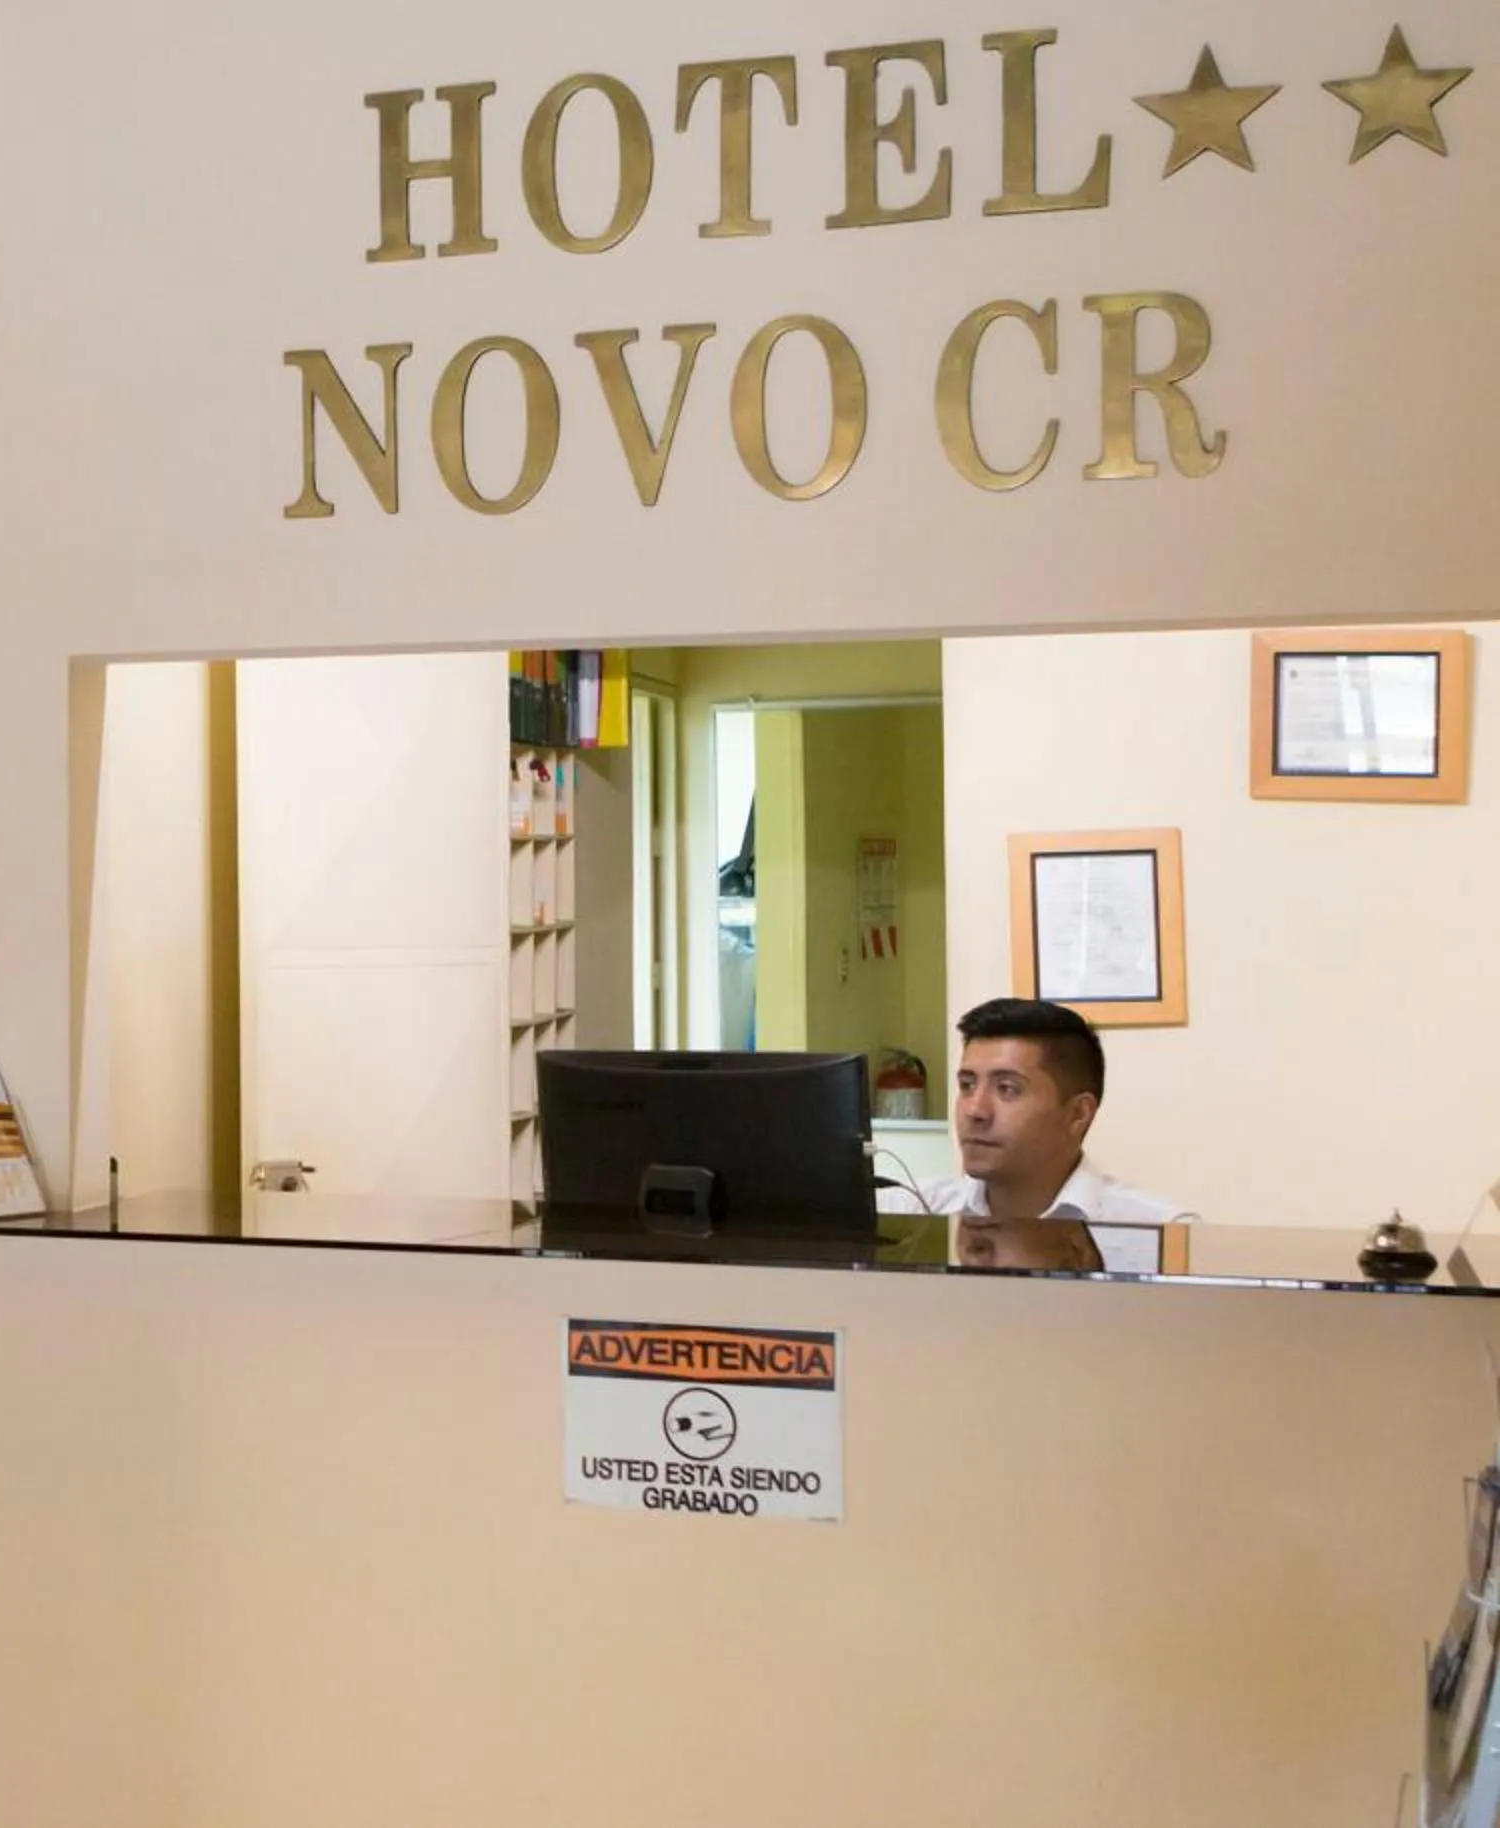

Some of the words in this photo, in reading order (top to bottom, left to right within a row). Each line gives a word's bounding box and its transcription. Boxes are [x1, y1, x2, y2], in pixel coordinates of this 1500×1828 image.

[364, 26, 1113, 264] HOTEL
[284, 313, 868, 518] NOVO
[935, 290, 1227, 492] CR
[574, 1334, 829, 1376] ADVERTENCIA
[581, 1456, 658, 1483] USTED
[665, 1462, 725, 1488] ESTA
[731, 1467, 821, 1495] SIENDO
[642, 1486, 759, 1517] GRABADO
